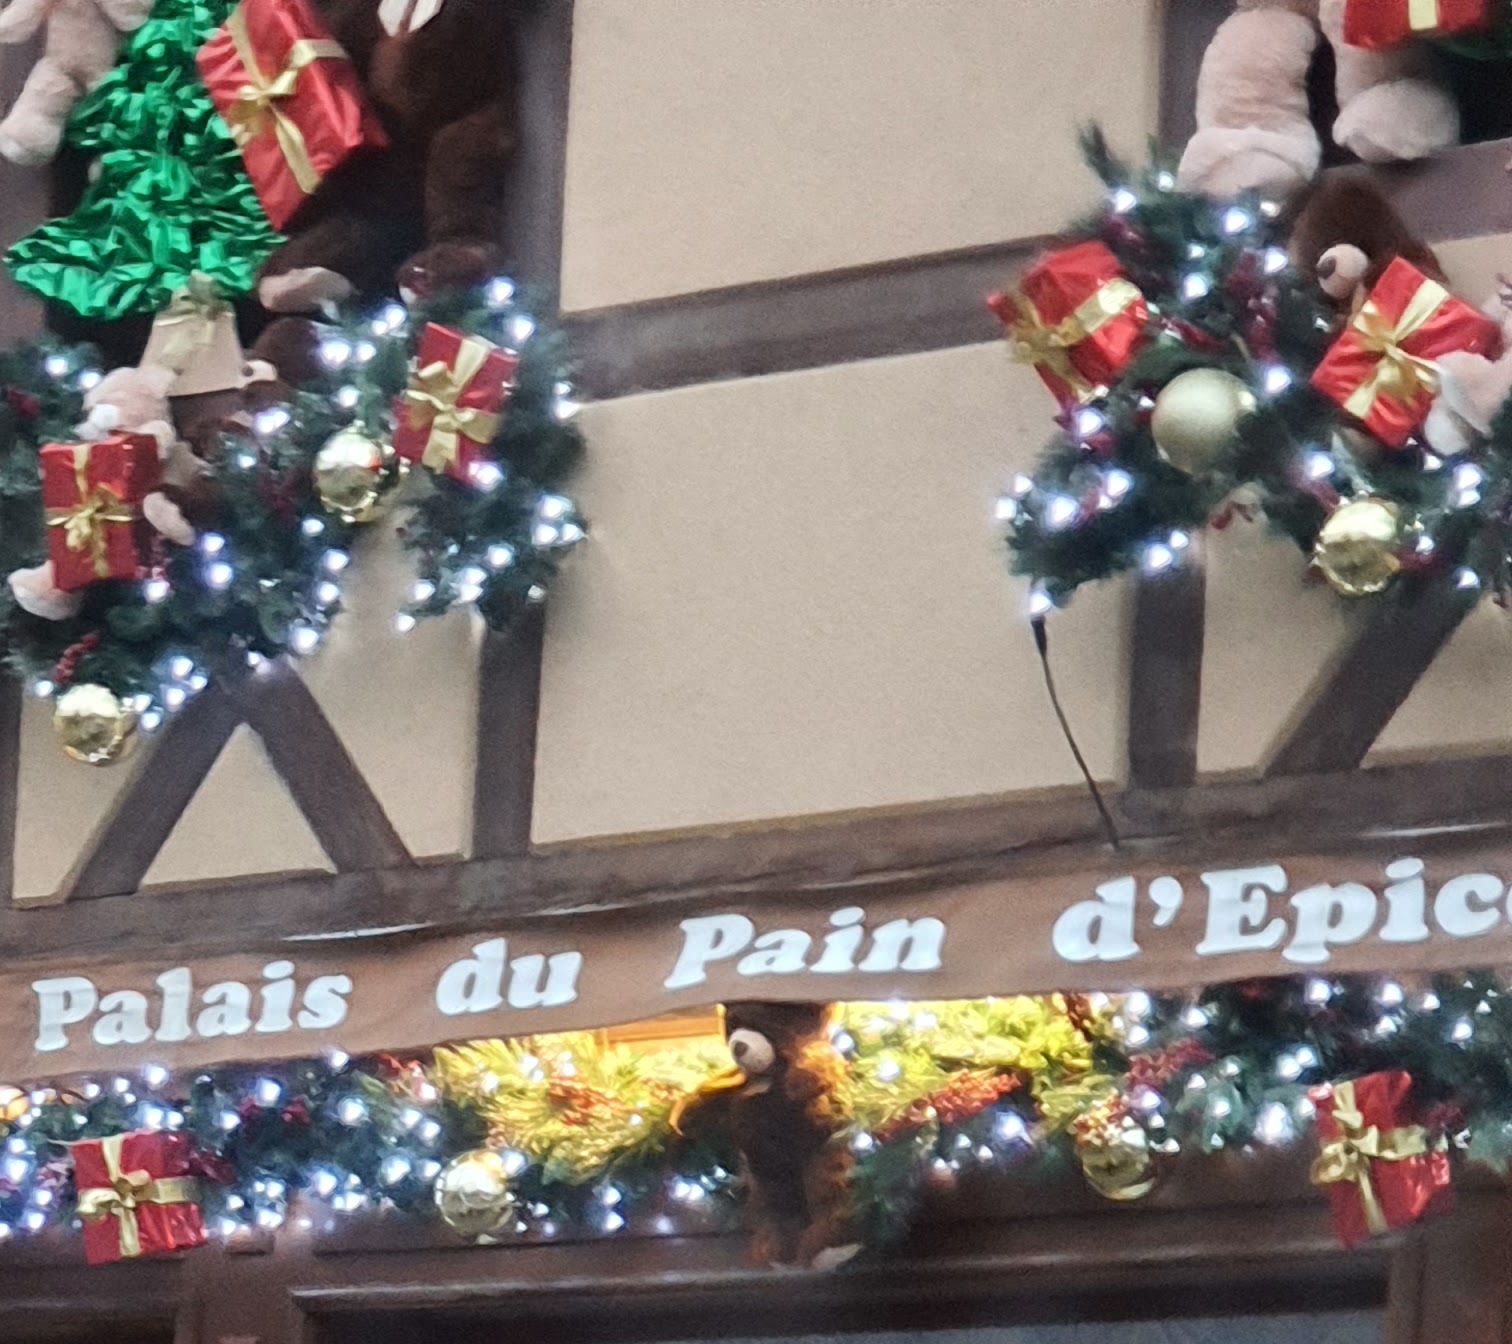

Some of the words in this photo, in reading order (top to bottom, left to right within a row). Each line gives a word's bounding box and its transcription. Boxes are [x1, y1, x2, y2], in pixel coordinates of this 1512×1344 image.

[31, 960, 353, 1053] Palais
[435, 938, 583, 1017] du
[664, 906, 947, 989] Pain
[1052, 857, 1512, 964] d'Epic
